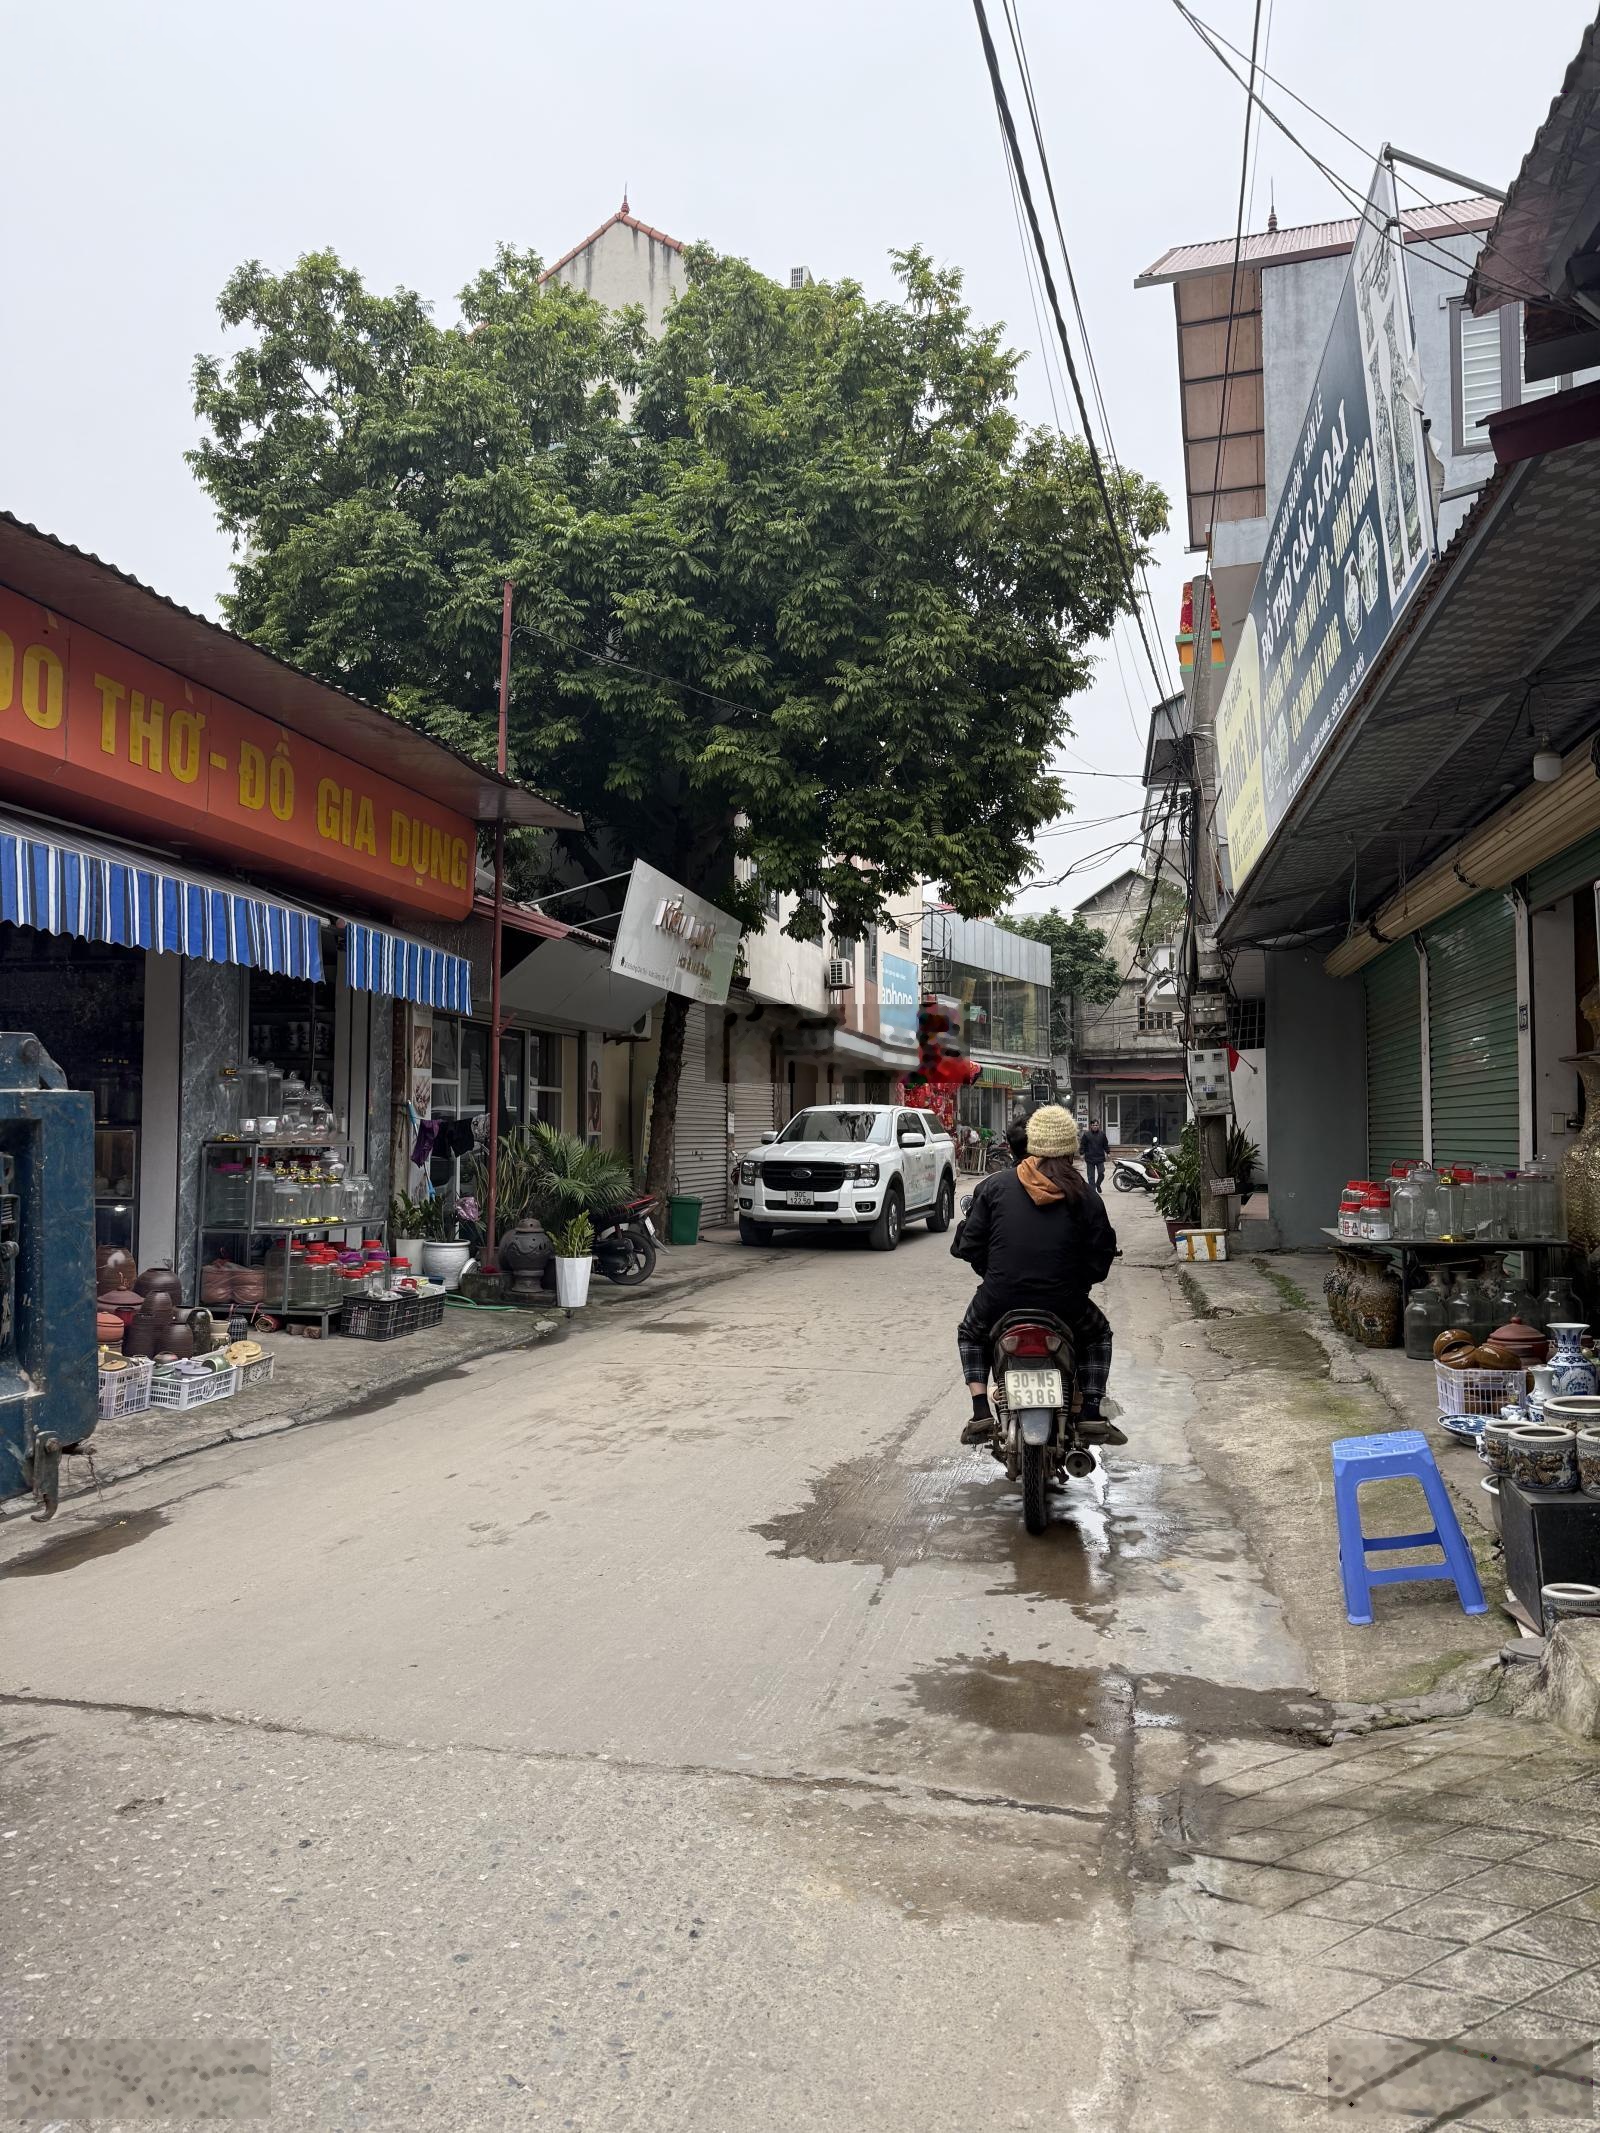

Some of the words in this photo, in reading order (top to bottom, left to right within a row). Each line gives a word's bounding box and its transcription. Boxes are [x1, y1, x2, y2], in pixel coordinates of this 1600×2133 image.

[1314, 382, 1323, 434] LẺ
[1261, 597, 1274, 671] ĐỒ
[1273, 554, 1292, 638] THỜ
[1292, 497, 1315, 584] CÁC
[1313, 398, 1348, 524] LOẠI
[1316, 544, 1331, 607] LỘC
[1349, 436, 1374, 529] ĐỒNG
[1322, 613, 1341, 679] VÀNG
[94, 671, 206, 784] THỜ
[239, 728, 295, 821] ĐỒ
[317, 777, 377, 857] GIA
[390, 809, 468, 890] DỤNG
[1012, 1371, 1055, 1388] 30-N5
[1013, 1388, 1056, 1406] 5386
